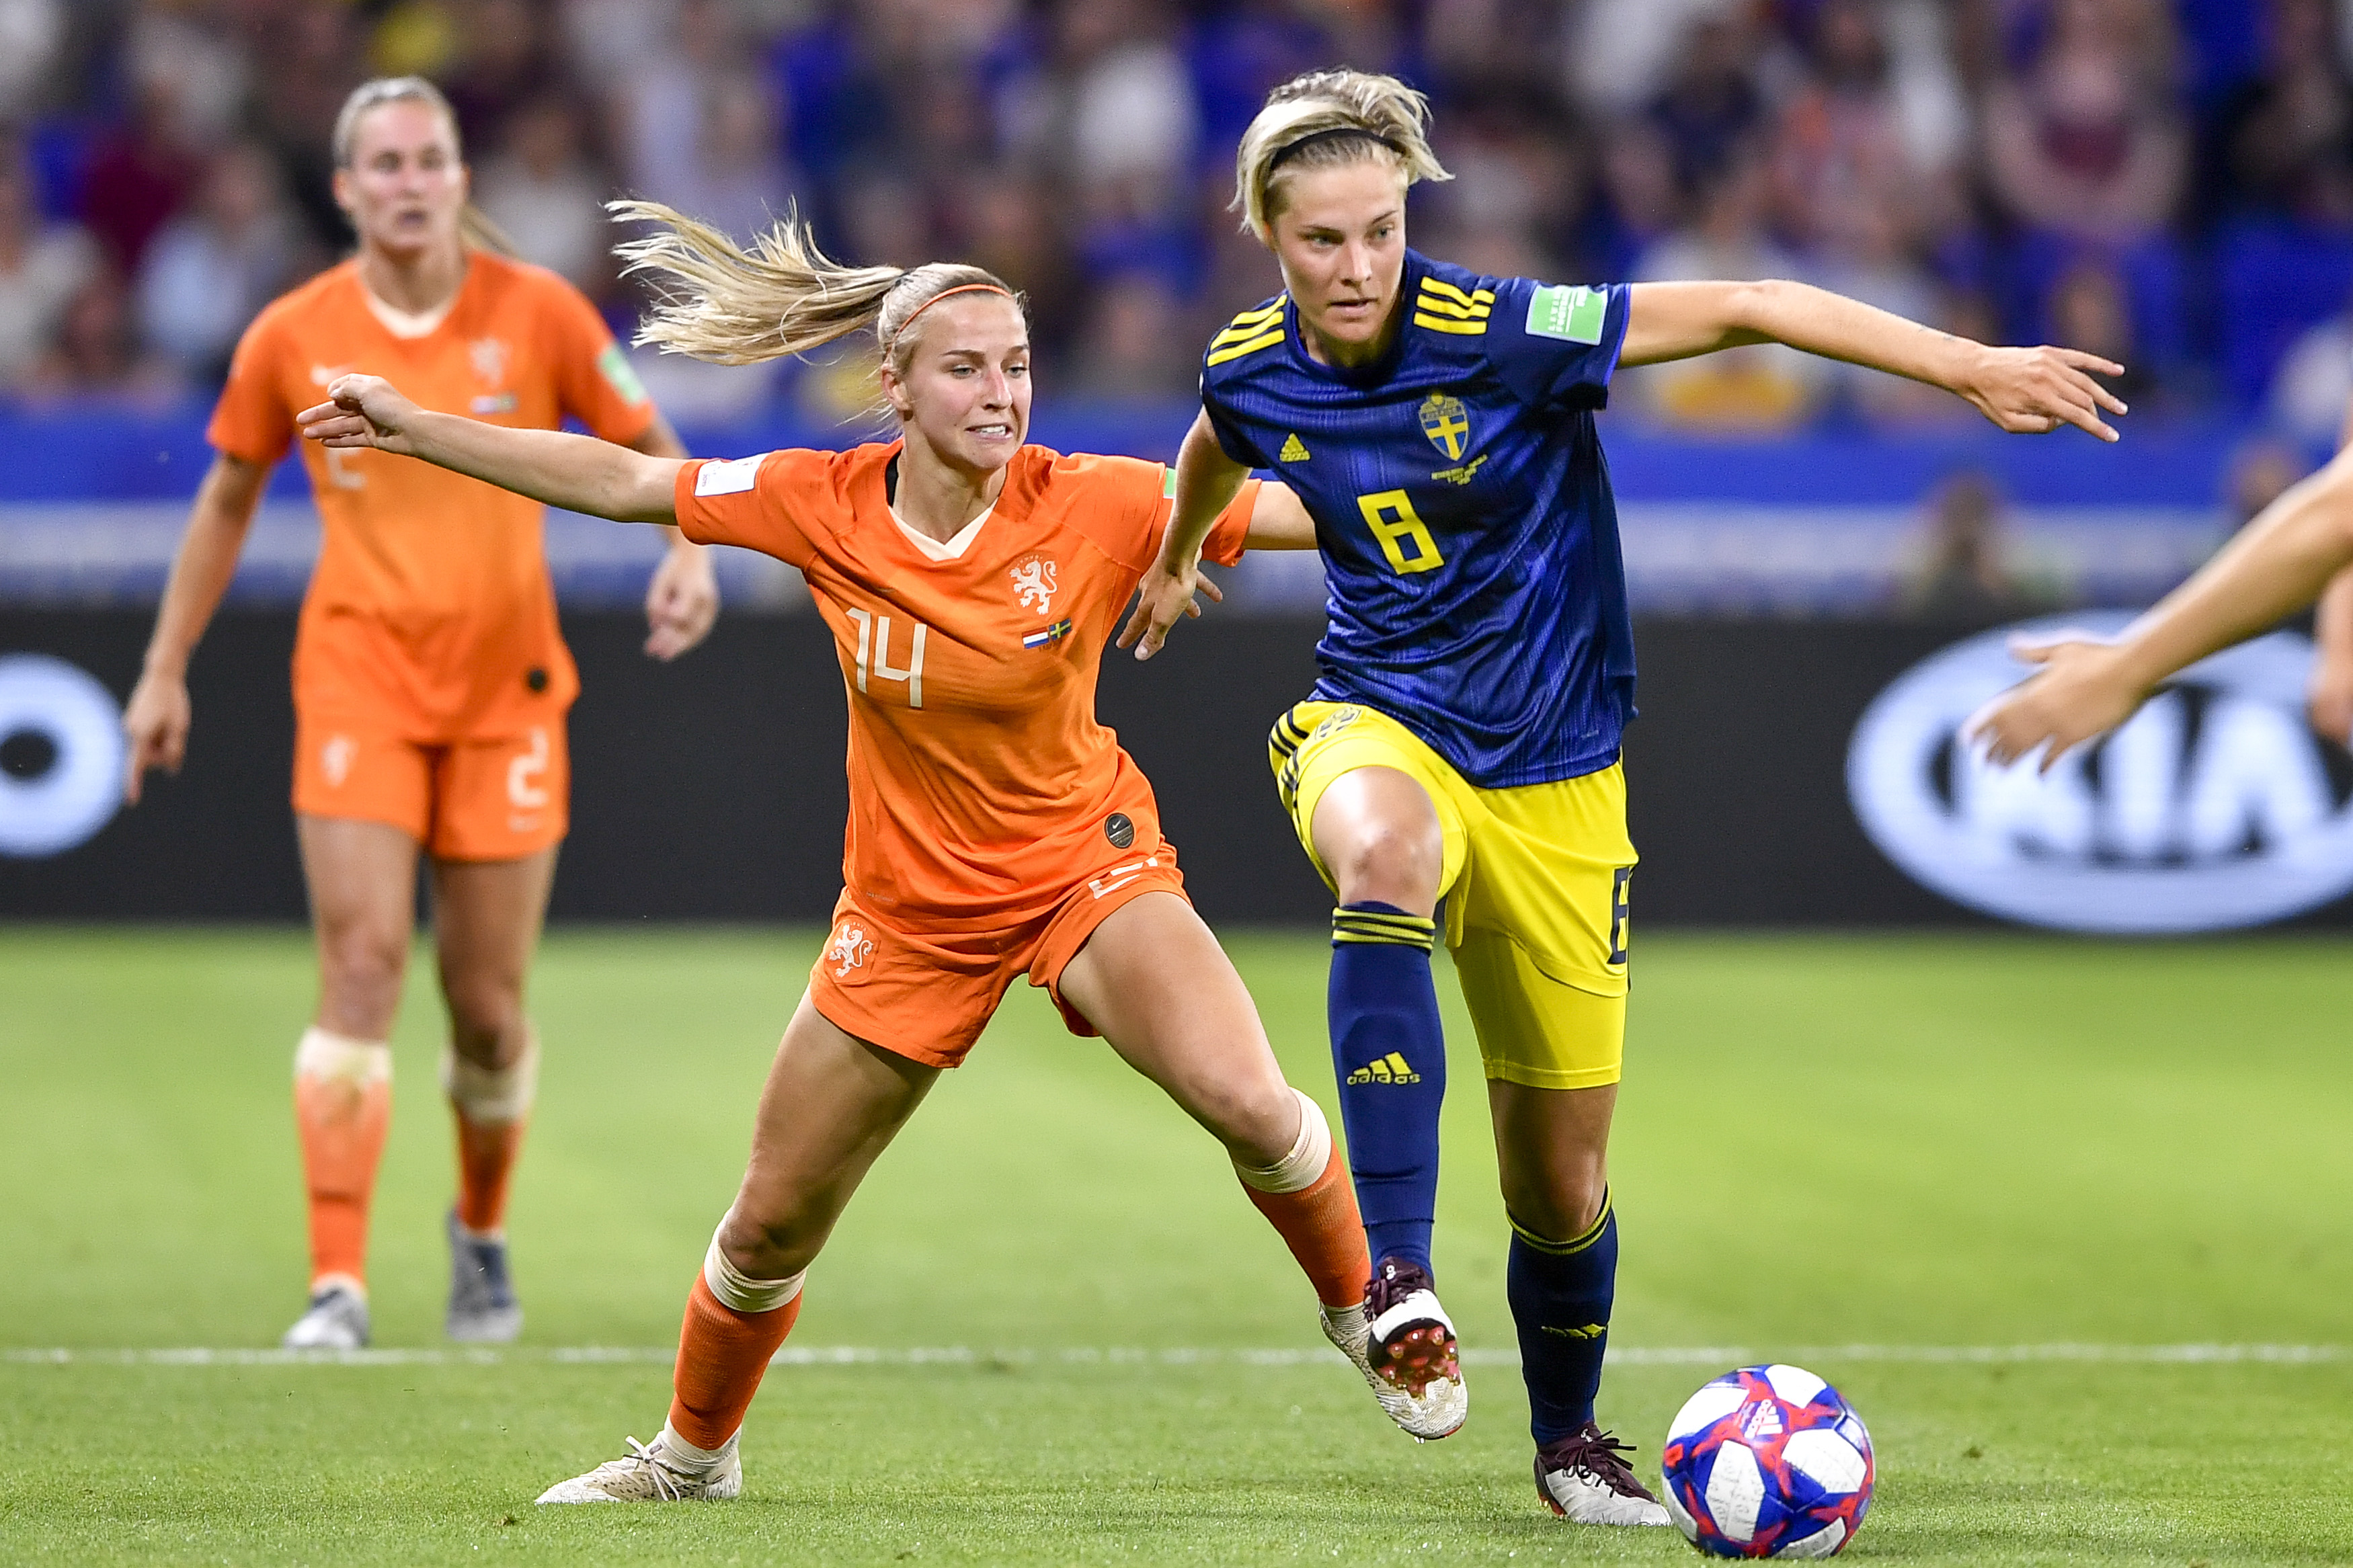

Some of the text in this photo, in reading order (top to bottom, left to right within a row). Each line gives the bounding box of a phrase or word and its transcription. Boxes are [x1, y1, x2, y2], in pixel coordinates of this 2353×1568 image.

[1357, 488, 1445, 575] 8
[845, 607, 928, 708] 14
[508, 726, 548, 807] 2
[1347, 1071, 1421, 1085] adidas
[1744, 1399, 1773, 1440] adidas
